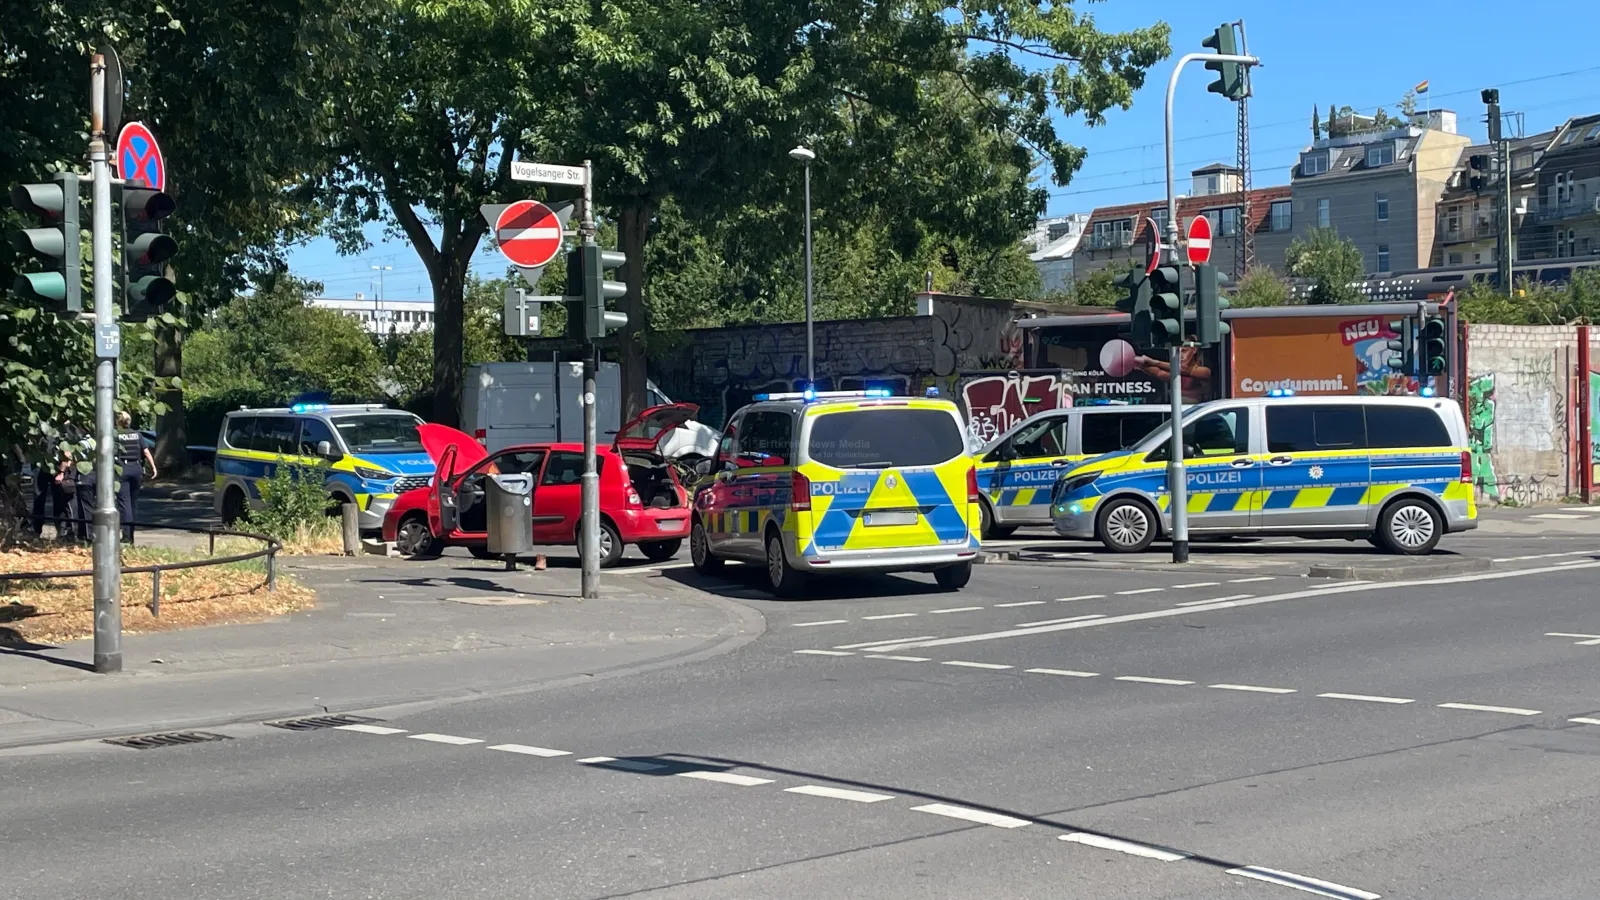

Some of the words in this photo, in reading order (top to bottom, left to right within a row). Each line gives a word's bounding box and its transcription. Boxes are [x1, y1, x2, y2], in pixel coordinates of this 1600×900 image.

[514, 164, 565, 180] Vogelsanger
[567, 169, 581, 180] Str.
[1344, 320, 1379, 341] NEU
[1088, 369, 1105, 377] KÖLN
[1094, 381, 1156, 394] FITNESS.
[1240, 374, 1349, 392] Cowgummi.
[1187, 471, 1241, 485] POLIZEI
